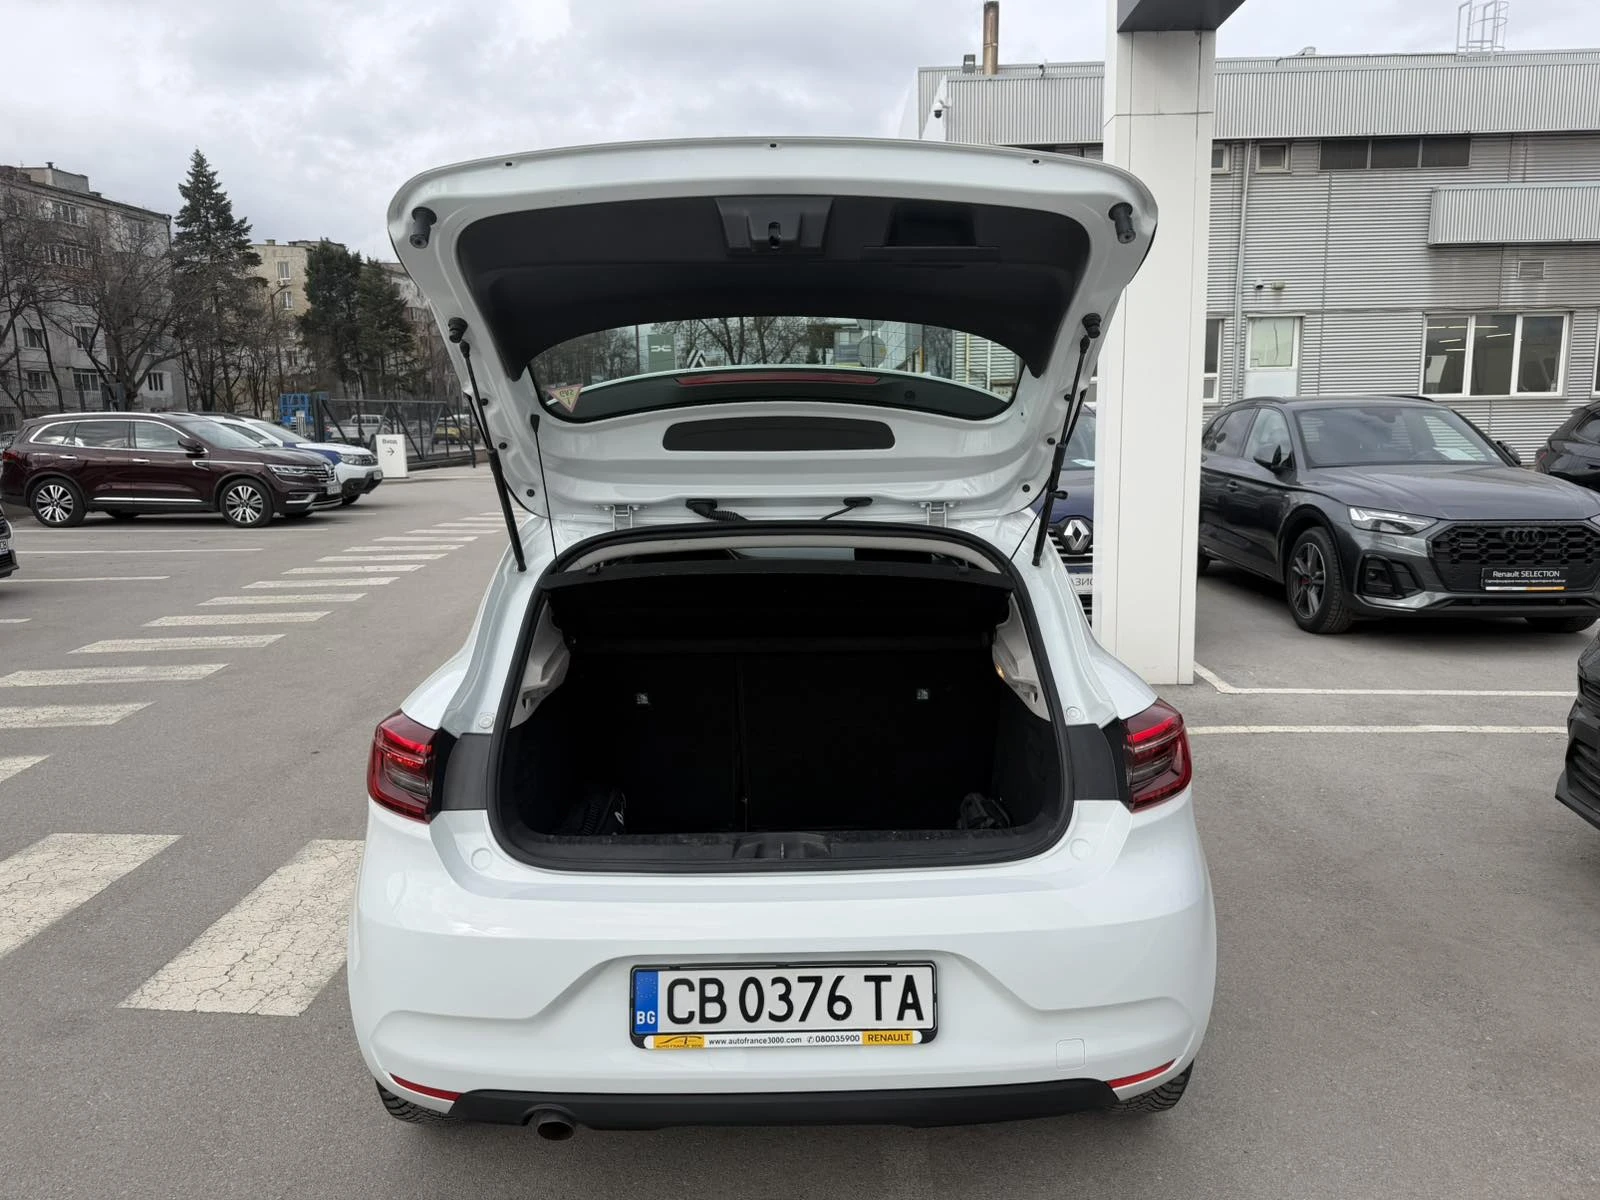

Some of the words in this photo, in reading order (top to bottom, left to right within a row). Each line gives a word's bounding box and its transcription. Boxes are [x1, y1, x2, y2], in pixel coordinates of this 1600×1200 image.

[1492, 570, 1519, 578] Renault
[1520, 570, 1560, 578] SELECTION
[667, 977, 727, 1025] CB
[738, 975, 853, 1023] 0376
[863, 974, 925, 1021] TA
[636, 1010, 656, 1025] BG
[708, 1036, 802, 1045] www.autofrance3000.com
[815, 1034, 860, 1043] 080035900
[867, 1033, 911, 1042] RENAULT
